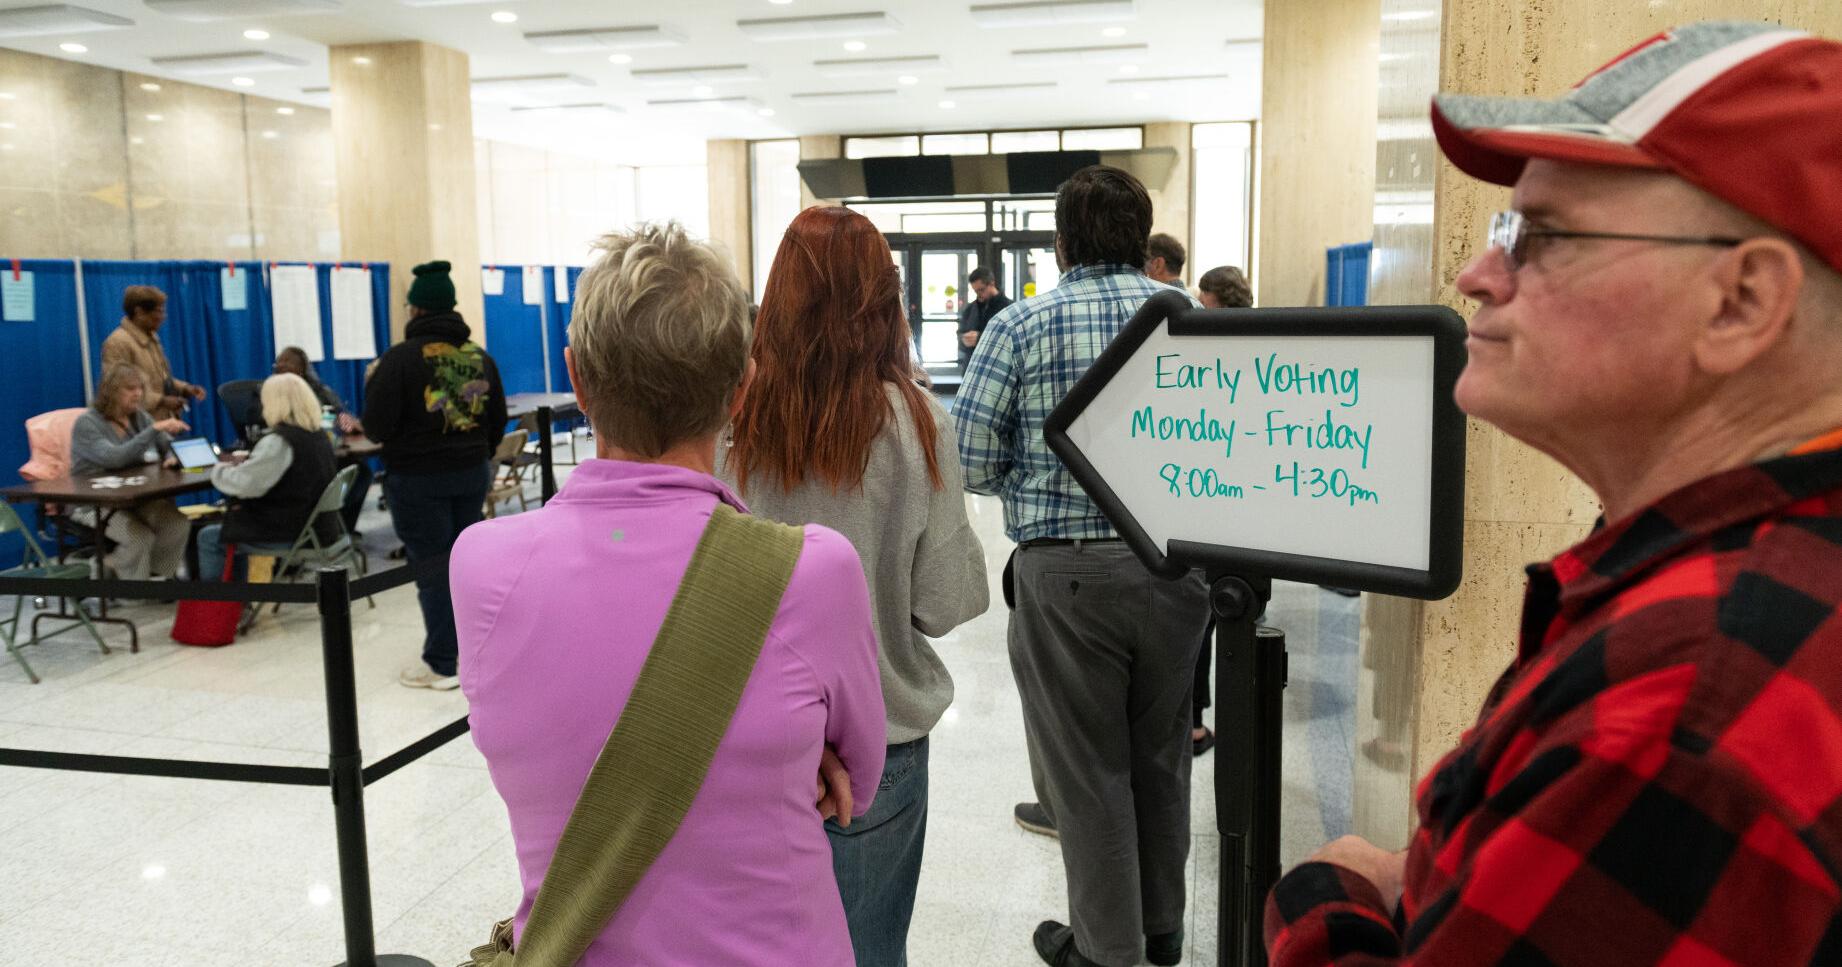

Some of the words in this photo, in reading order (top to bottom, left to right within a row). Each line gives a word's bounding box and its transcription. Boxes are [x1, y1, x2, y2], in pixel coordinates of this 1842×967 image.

[1156, 353, 1241, 404] Early
[1254, 352, 1360, 407] Voting
[1131, 405, 1236, 458] Monday
[1265, 409, 1373, 469] Friday
[1158, 463, 1244, 499] 8:00am
[1275, 461, 1380, 506] 4:30pm
